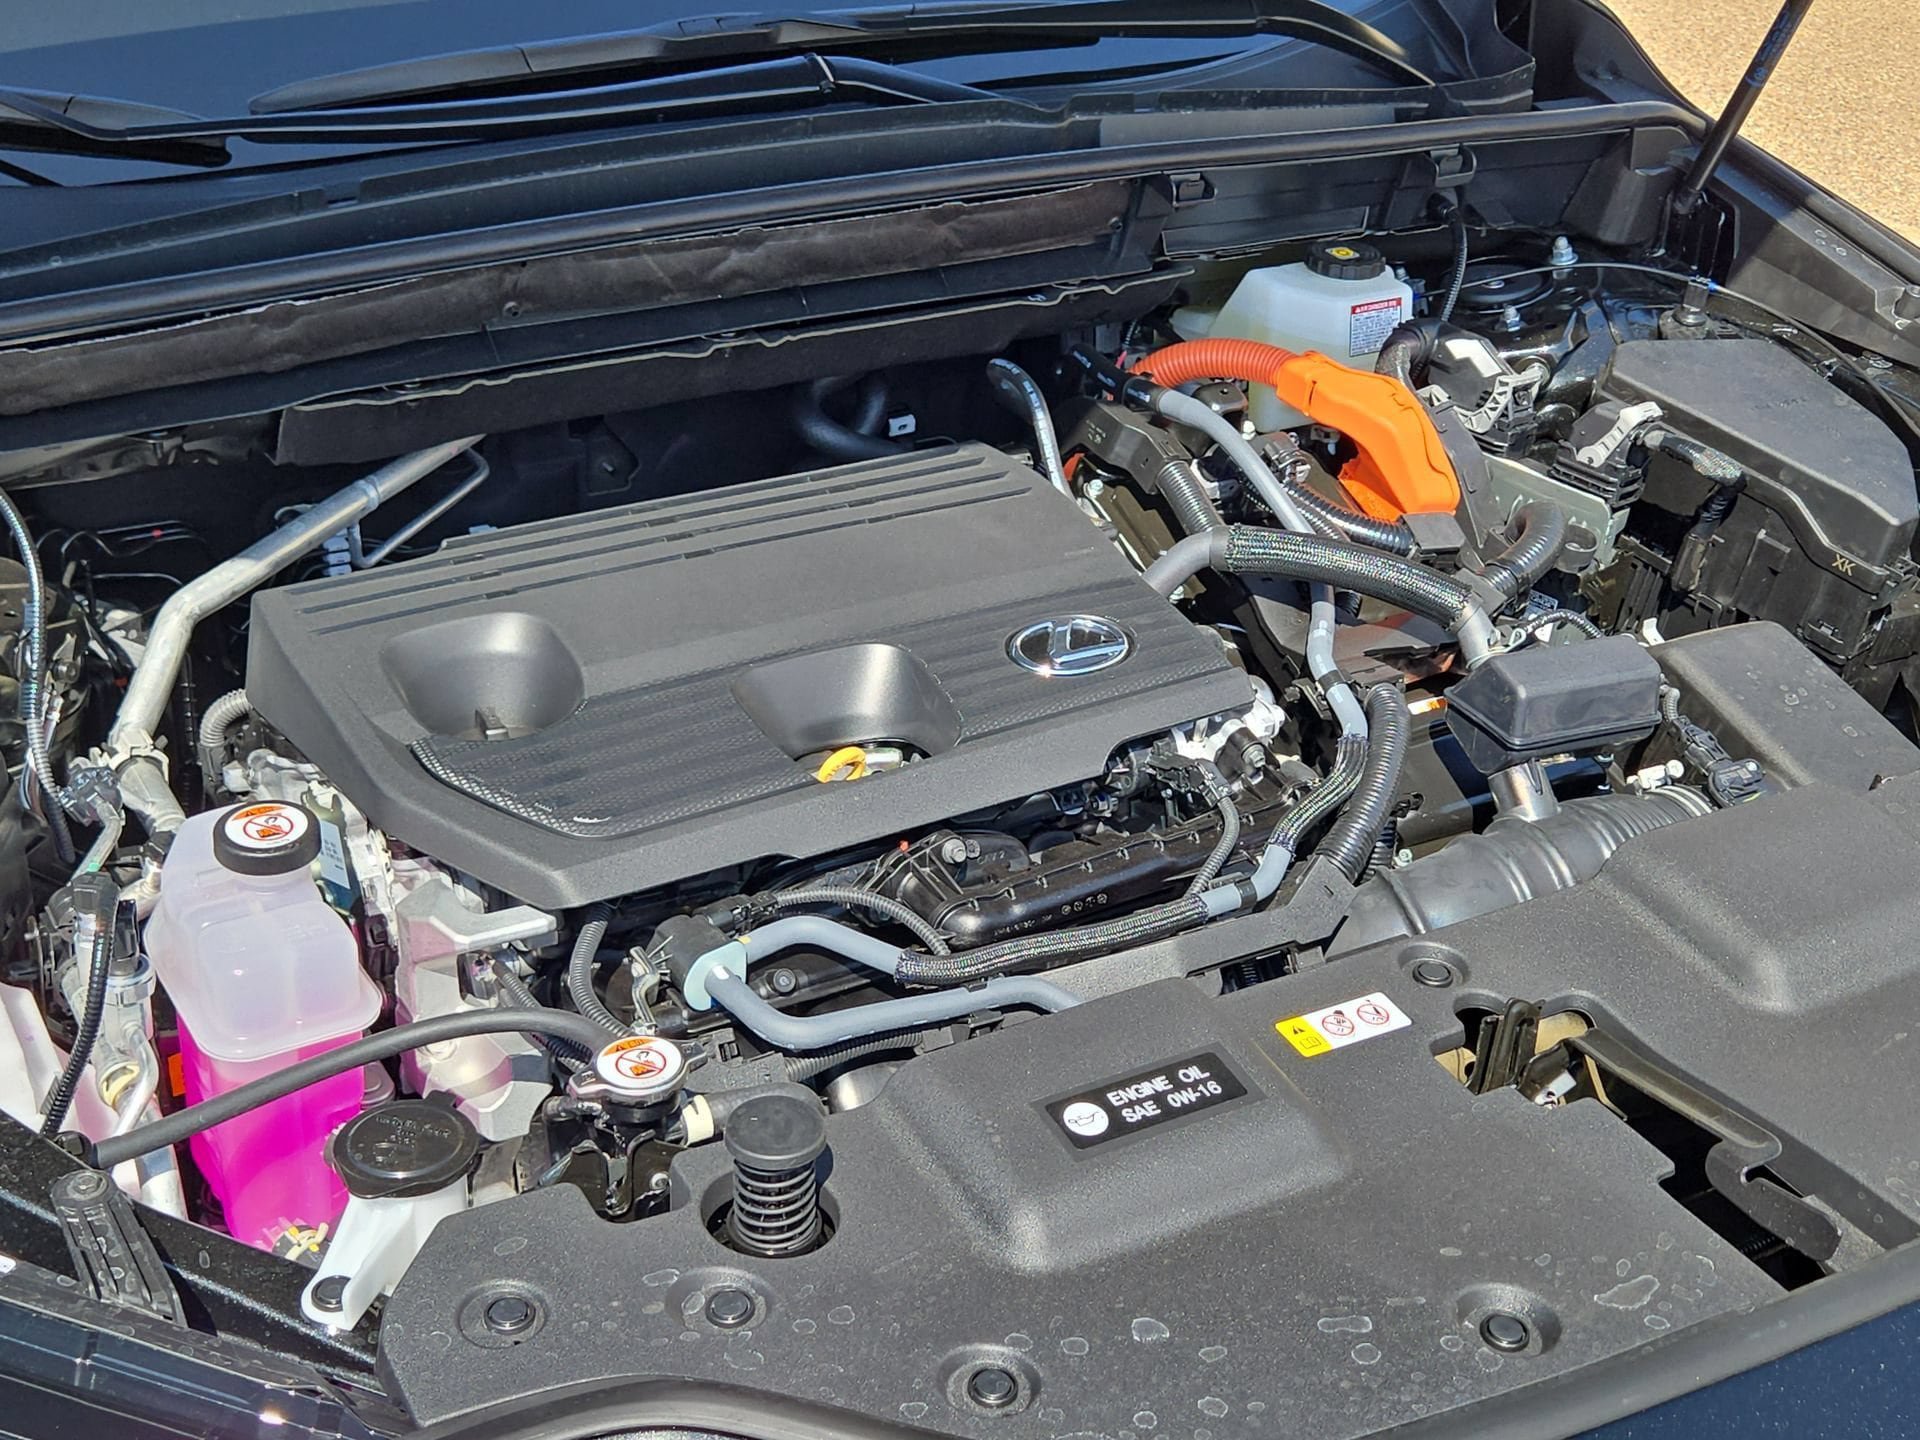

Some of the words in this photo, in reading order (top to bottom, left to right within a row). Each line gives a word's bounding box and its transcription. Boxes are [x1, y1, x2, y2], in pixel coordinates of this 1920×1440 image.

[1832, 554, 1856, 576] XK
[1106, 1075, 1174, 1107] ENGINE
[1178, 1065, 1210, 1083] OIL
[1121, 1100, 1161, 1123] SAE
[1167, 1081, 1223, 1108] 0W-16
